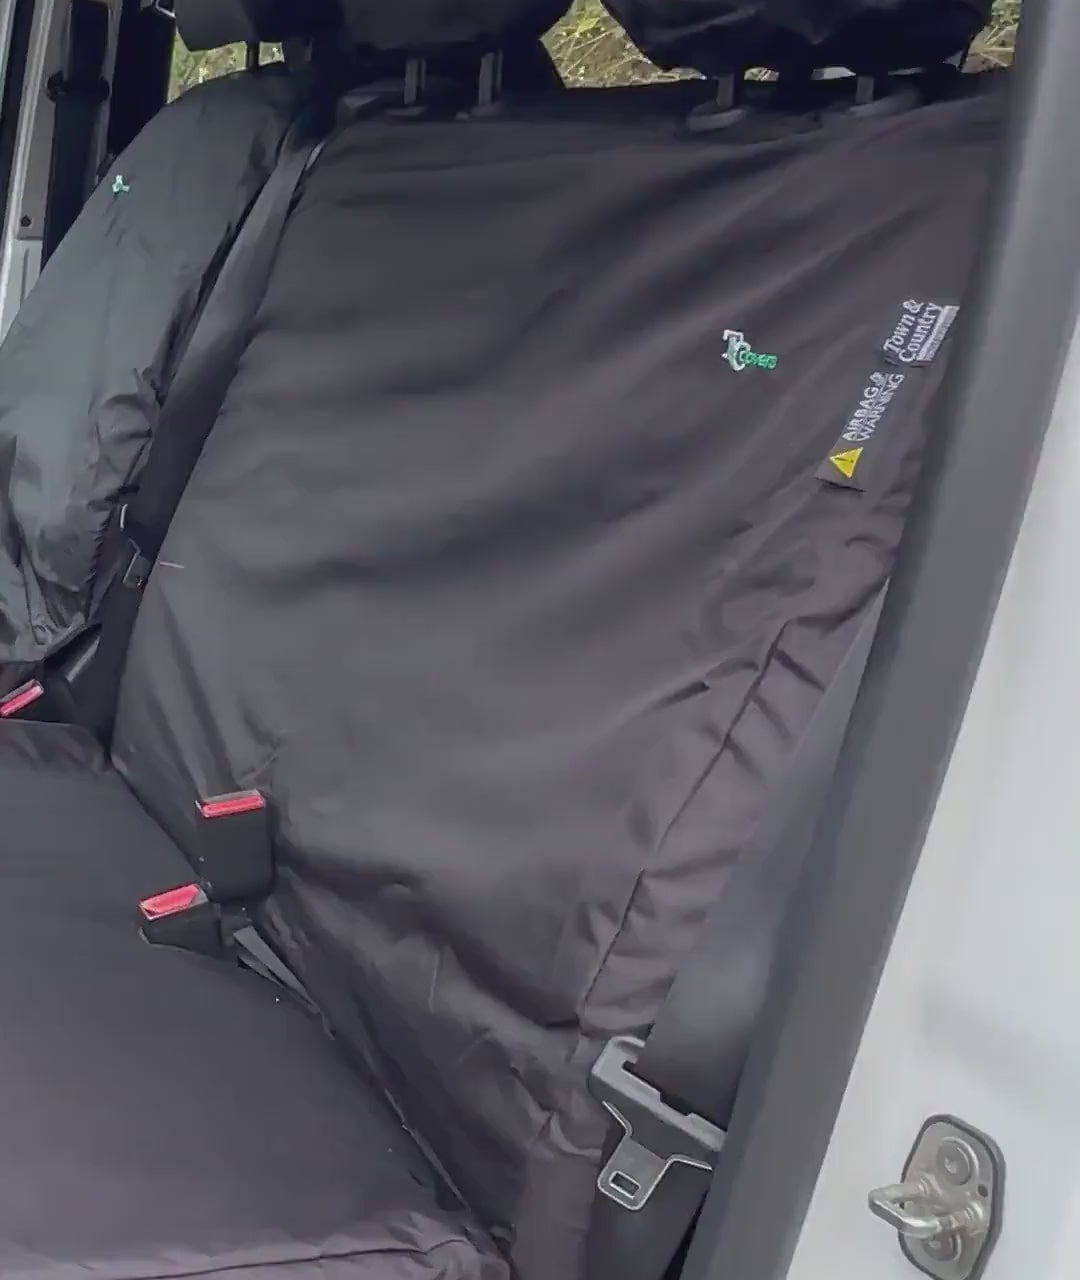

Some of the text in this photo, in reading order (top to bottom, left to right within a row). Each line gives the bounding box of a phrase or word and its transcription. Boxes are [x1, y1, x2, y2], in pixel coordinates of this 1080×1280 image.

[883, 299, 924, 353] Town &
[898, 302, 943, 362] Country
[842, 386, 879, 442] AIRBAG
[856, 374, 904, 442] WARNING
